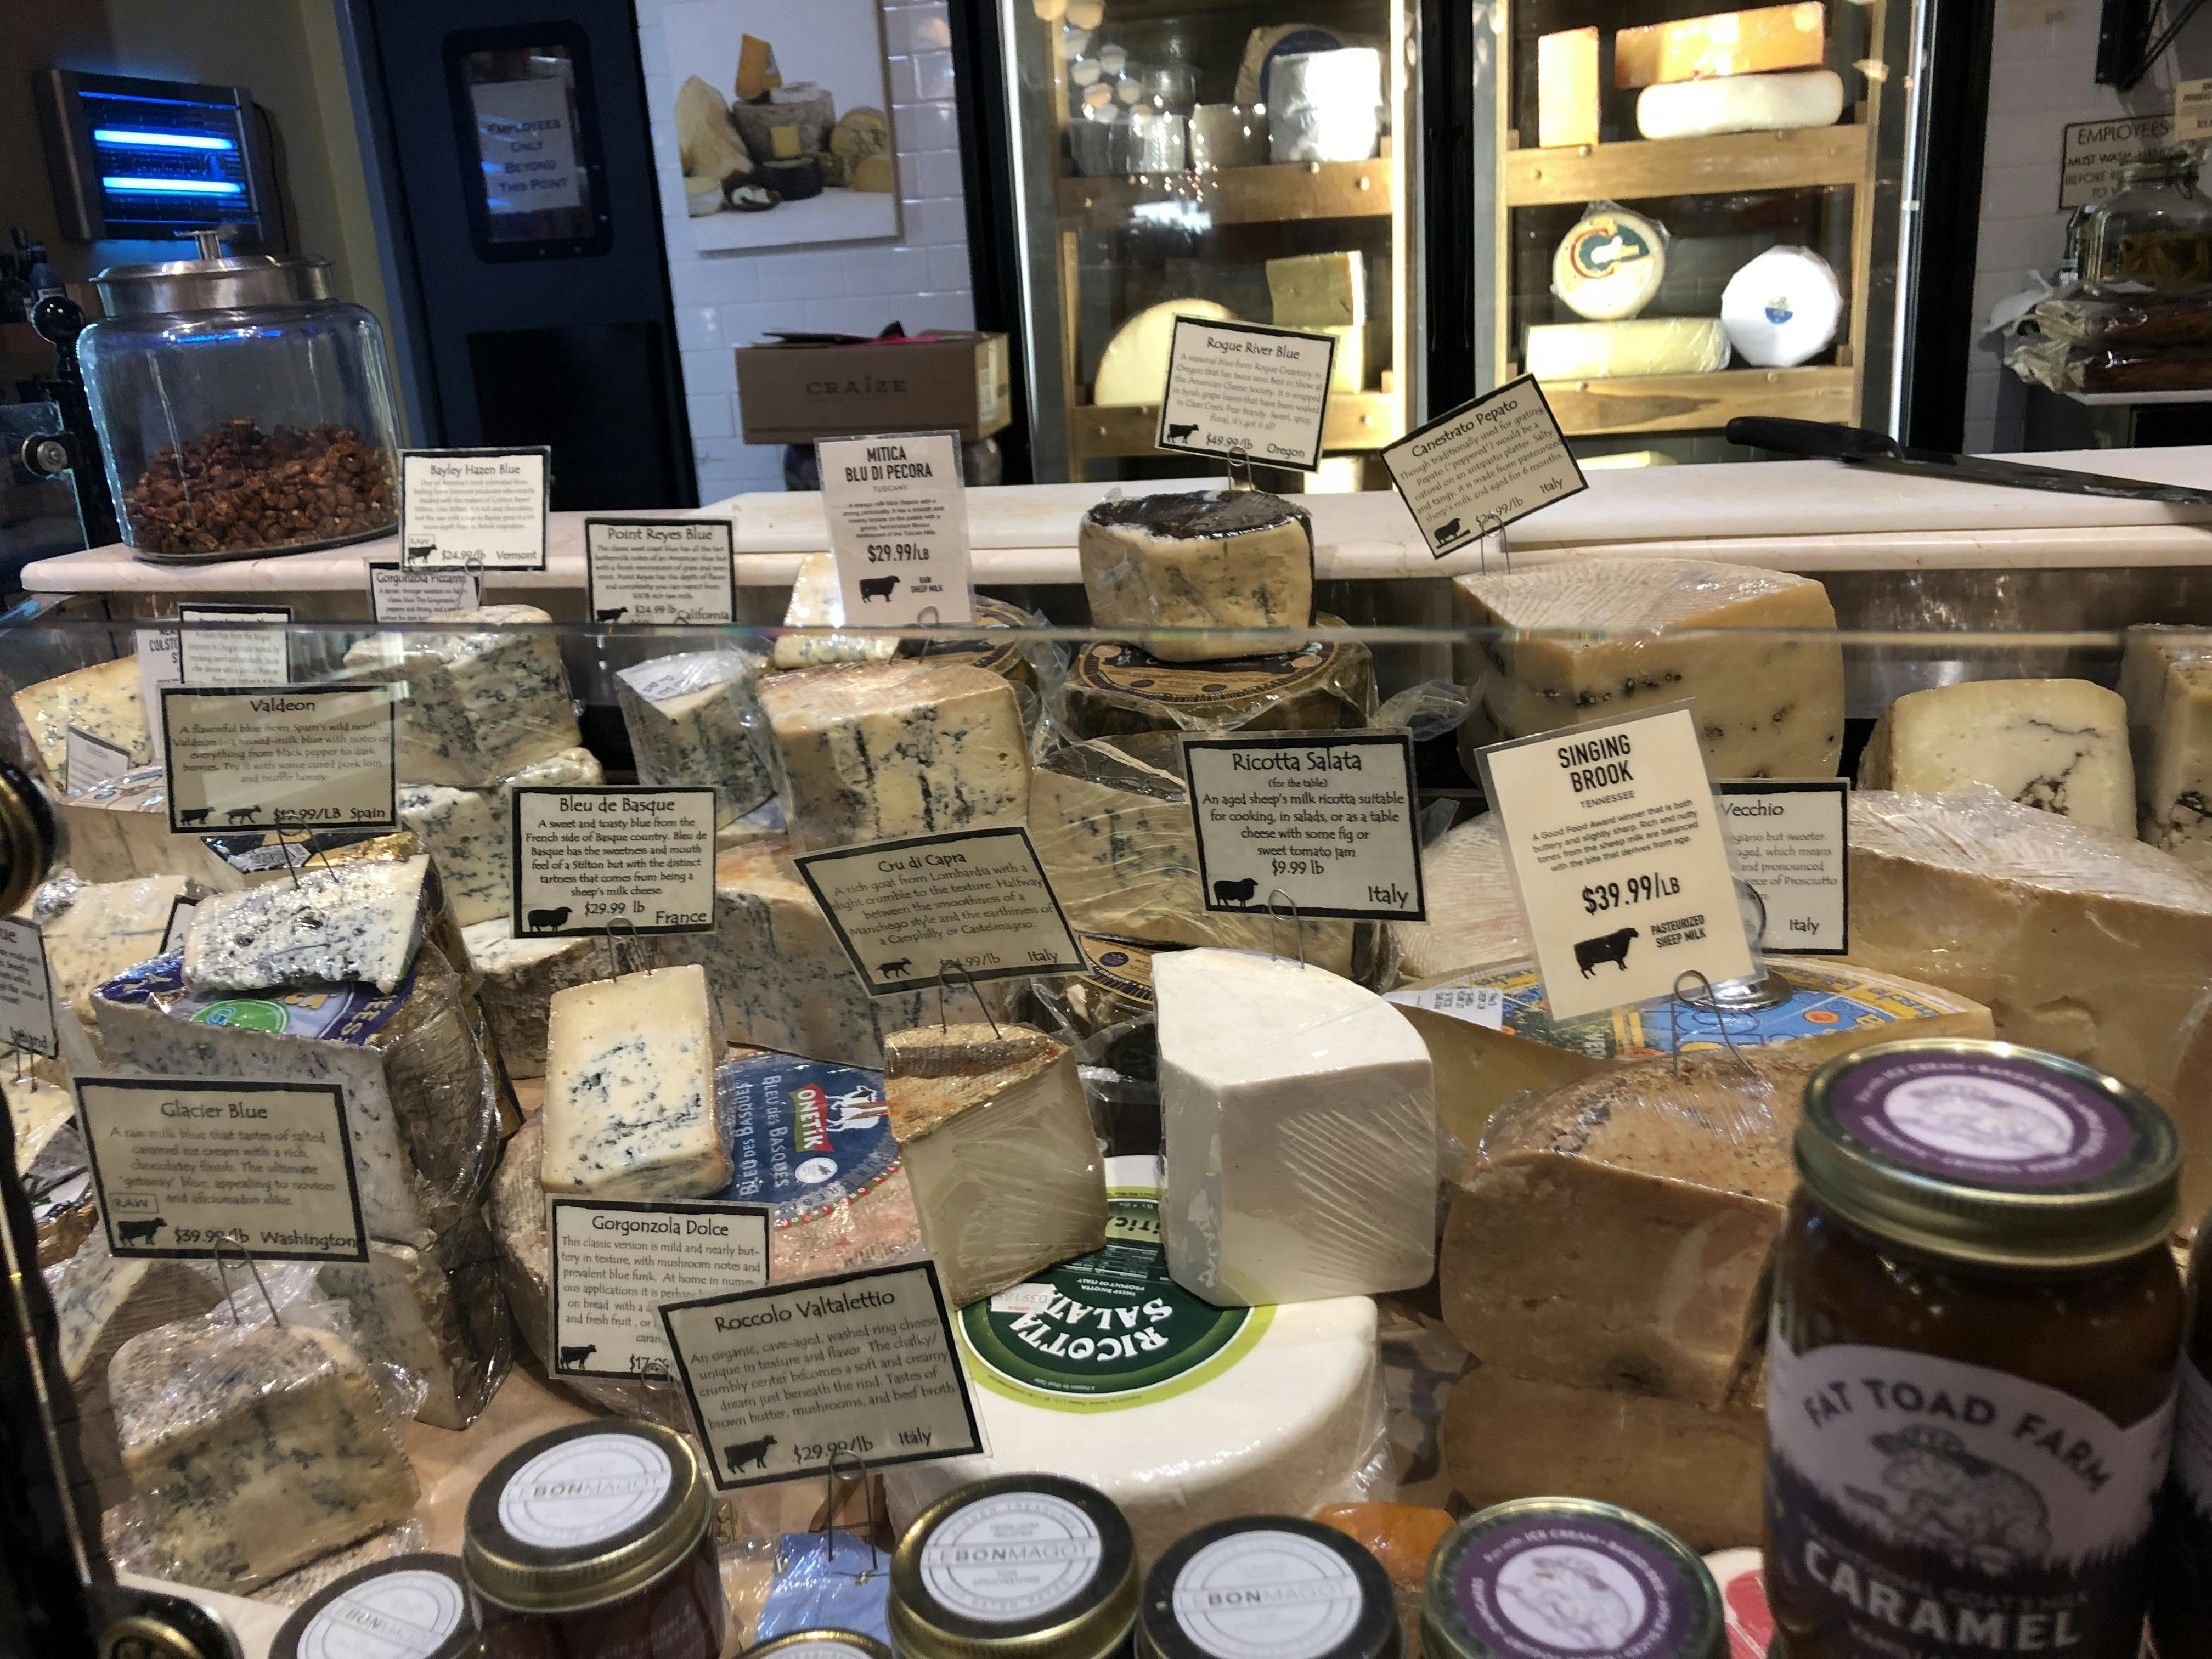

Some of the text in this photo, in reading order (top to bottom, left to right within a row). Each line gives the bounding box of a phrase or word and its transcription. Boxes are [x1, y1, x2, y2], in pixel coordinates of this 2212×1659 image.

[2078, 120, 2168, 145] EMPLOYEES
[1207, 337, 1300, 360] Rogue River Blue
[1412, 400, 1518, 457] Canestrato Pepato
[866, 446, 906, 462] MITICA
[1267, 443, 1305, 459] Oregon
[431, 463, 520, 478] Bayley Hazen Blue
[845, 462, 932, 482] BLU DI PECORA
[1540, 478, 1562, 494] Italy
[608, 527, 713, 543] Point Reyes Blue
[496, 550, 537, 560] Vermont
[868, 544, 930, 563] $29.99/LB
[678, 608, 729, 620] California
[250, 698, 315, 712] Valdeon
[1233, 747, 1362, 771] Ricotta Salata
[1558, 734, 1631, 769] SINGING
[1268, 778, 1328, 788] (for the table)
[1570, 760, 1634, 793] BROOK
[560, 796, 675, 816] Bleu de Basque
[1203, 791, 1404, 807] An aged sheep's milk ricotta suitable
[1580, 790, 1635, 809] TENNESSEE
[1720, 800, 1784, 816] Vecchio
[350, 809, 386, 819] Spain
[599, 820, 628, 829] toasty
[631, 818, 651, 827] blue
[653, 817, 676, 827] from
[679, 818, 695, 826] the
[1211, 810, 1226, 821] for
[1229, 811, 1276, 825] cooking,
[1279, 812, 1290, 822] in
[1293, 811, 1328, 823] salads,
[1346, 814, 1357, 822] as
[1370, 810, 1400, 822] table
[526, 832, 707, 844] French side of Basque country. Bleu de
[1242, 827, 1276, 838] cheese
[1278, 827, 1302, 839] with
[1338, 827, 1353, 843] fig
[1357, 831, 1369, 839] or
[878, 852, 967, 873] Cru di Capra
[1257, 846, 1355, 860] sweet tomato jam
[1272, 859, 1324, 876] $9.99 lb
[1368, 883, 1409, 909] Italy
[1582, 872, 1680, 915] $39.99/LB
[585, 901, 645, 917] $29.99 lb
[656, 911, 707, 924] France
[1650, 915, 1705, 936] PASTEURIZED
[1790, 917, 1820, 935] Italy
[1656, 928, 1706, 948] SHEEP MILK
[1028, 949, 1057, 964] Italy
[762, 1075, 782, 1106] BLEU
[161, 1101, 268, 1119] Glacier Blue
[735, 1082, 754, 1137] BASQUES
[798, 1088, 823, 1149] ONETIK
[769, 1126, 789, 1188] BASQUES
[737, 1158, 759, 1197] BLEU
[115, 1199, 148, 1208] RAW
[592, 1216, 729, 1236] Gorgonzola Dolce
[261, 1230, 358, 1250] Washington
[562, 1237, 760, 1257] This classic version is mild and nearly but-
[715, 1291, 895, 1332] Roccolo Valtalettio
[1009, 1312, 1169, 1361] RICOTTA
[899, 1428, 932, 1448] Italy
[1803, 1378, 2113, 1493] FAT TOAD FARM
[1804, 1539, 2083, 1652] CARAMEL
